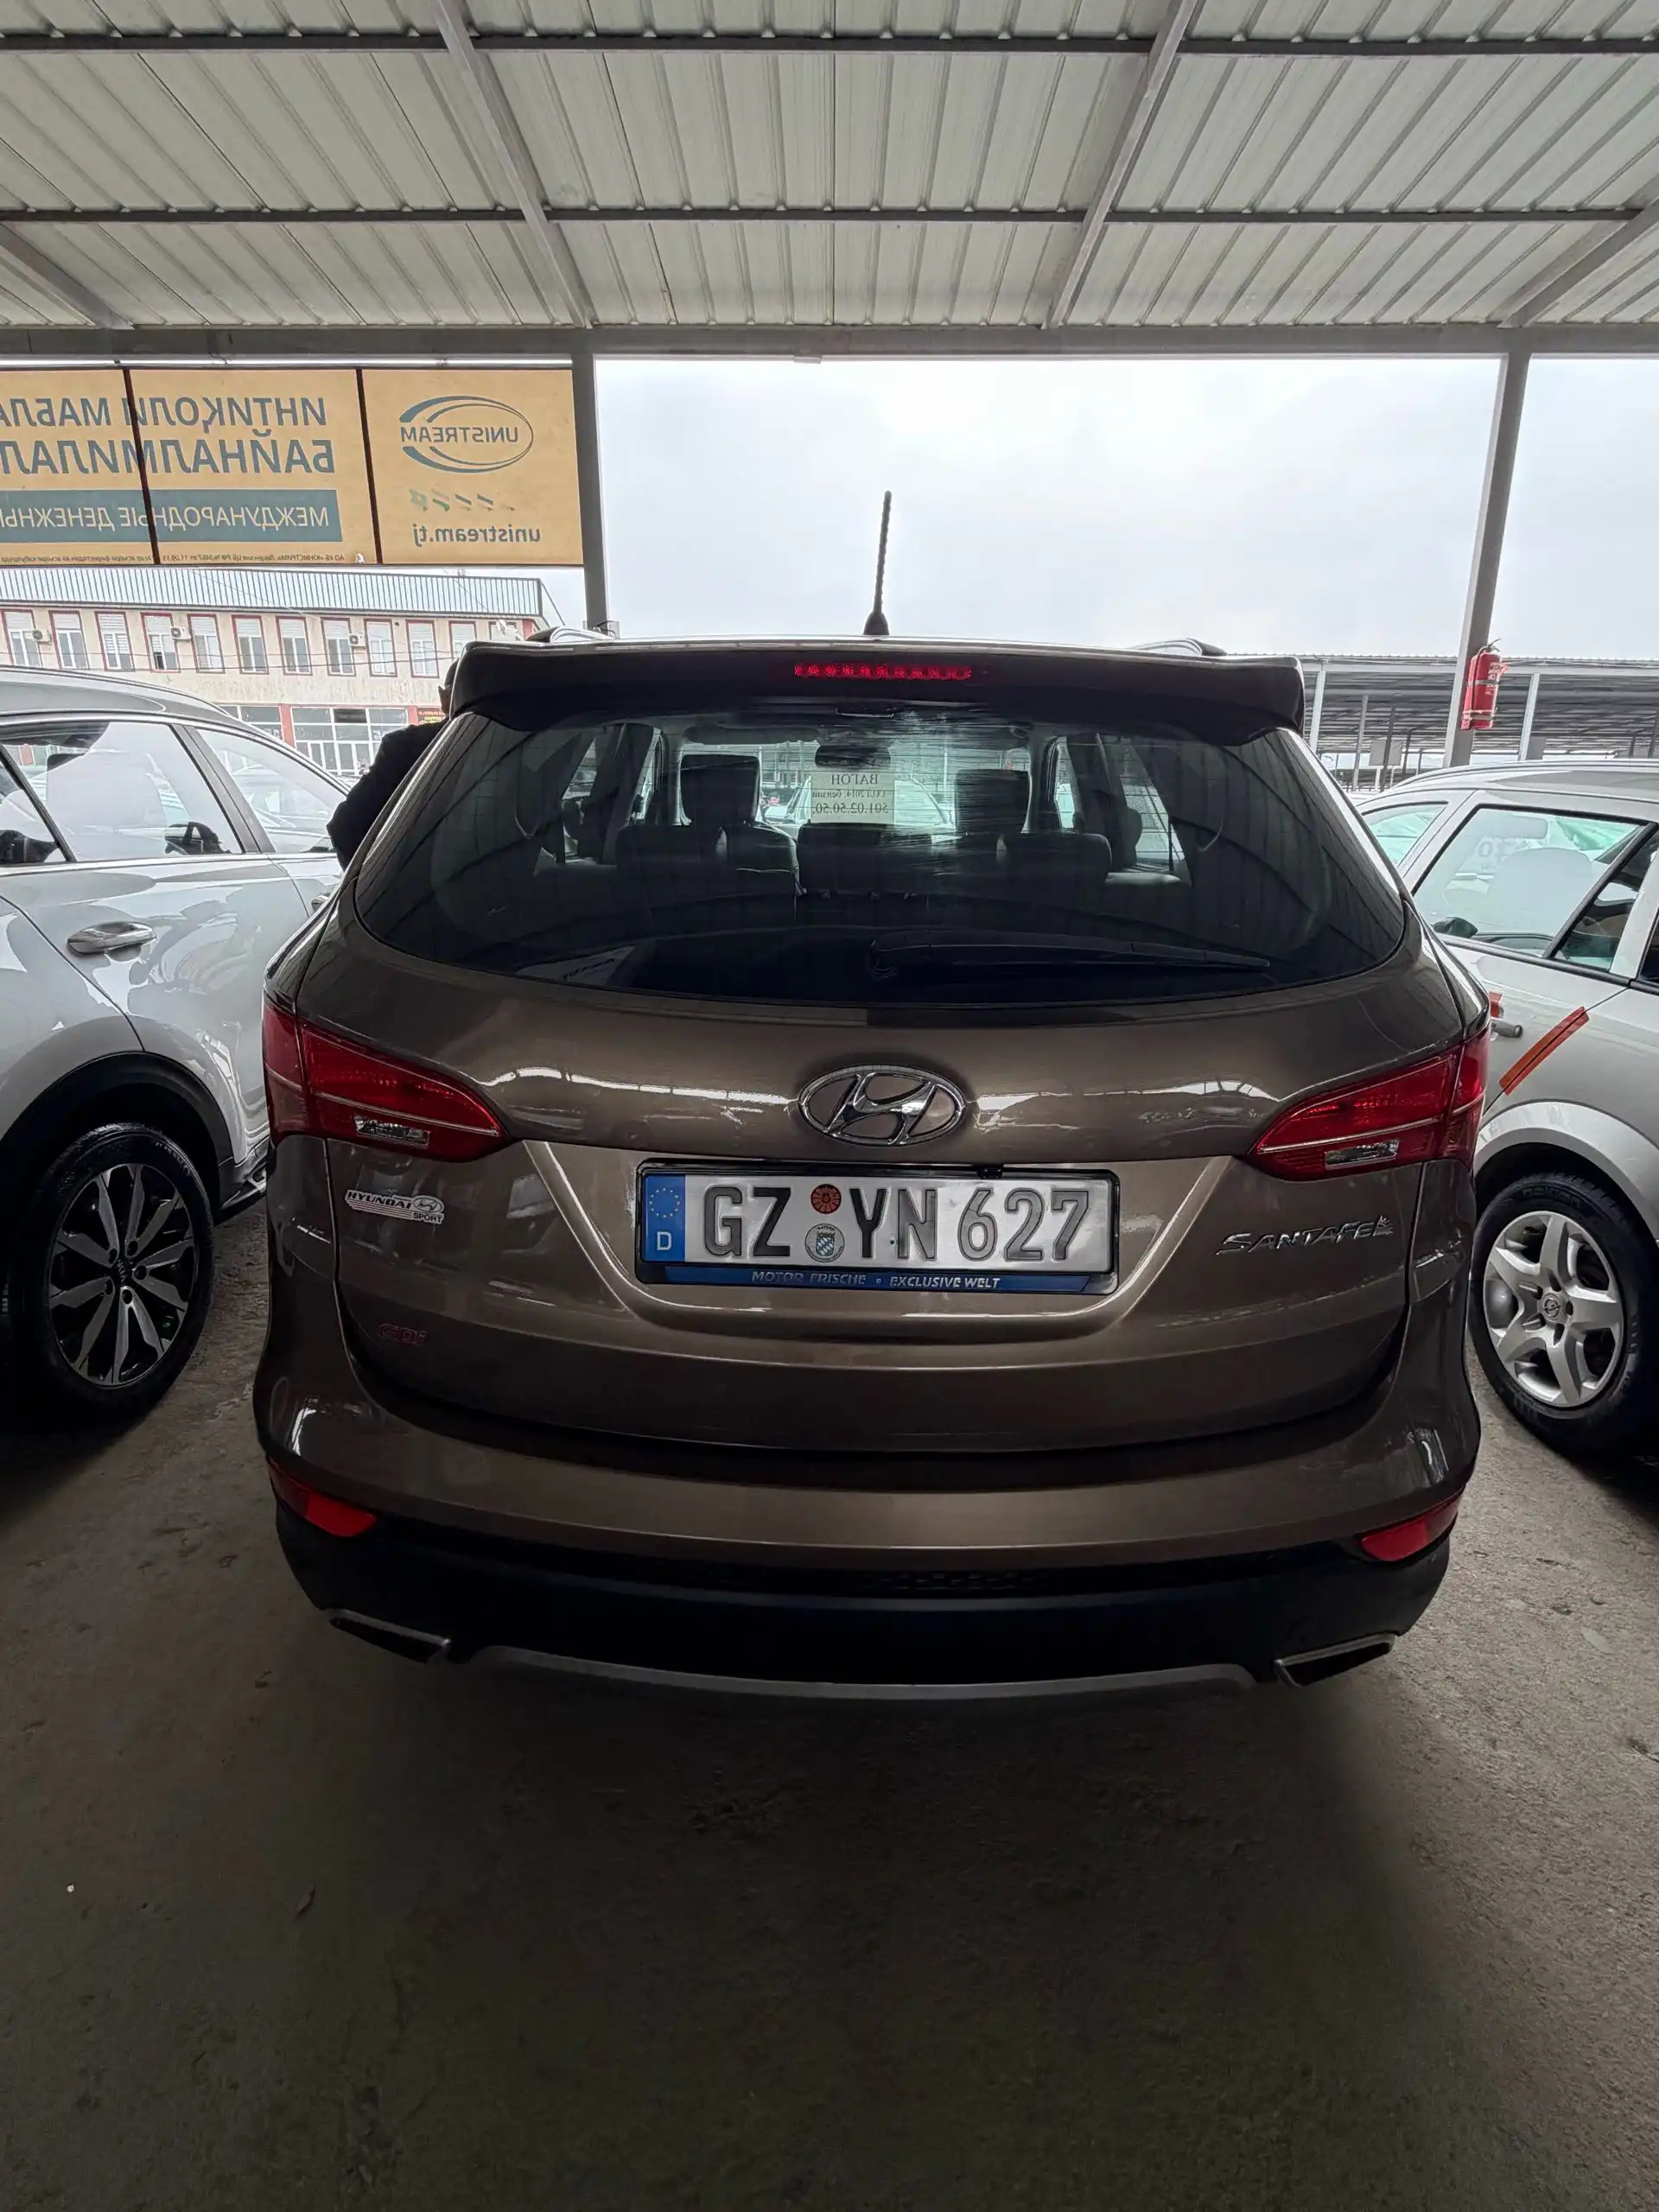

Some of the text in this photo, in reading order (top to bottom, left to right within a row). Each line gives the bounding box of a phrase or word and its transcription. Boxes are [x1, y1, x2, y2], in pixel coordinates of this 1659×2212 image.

[346, 1192, 412, 1210] HYUNDAI
[413, 1212, 443, 1223] SPORT
[703, 1185, 1090, 1262] GZ YN 627
[657, 1231, 672, 1251] D
[750, 1270, 1001, 1288] MOTOR FRISCHE EXCLUSIVE WELT
